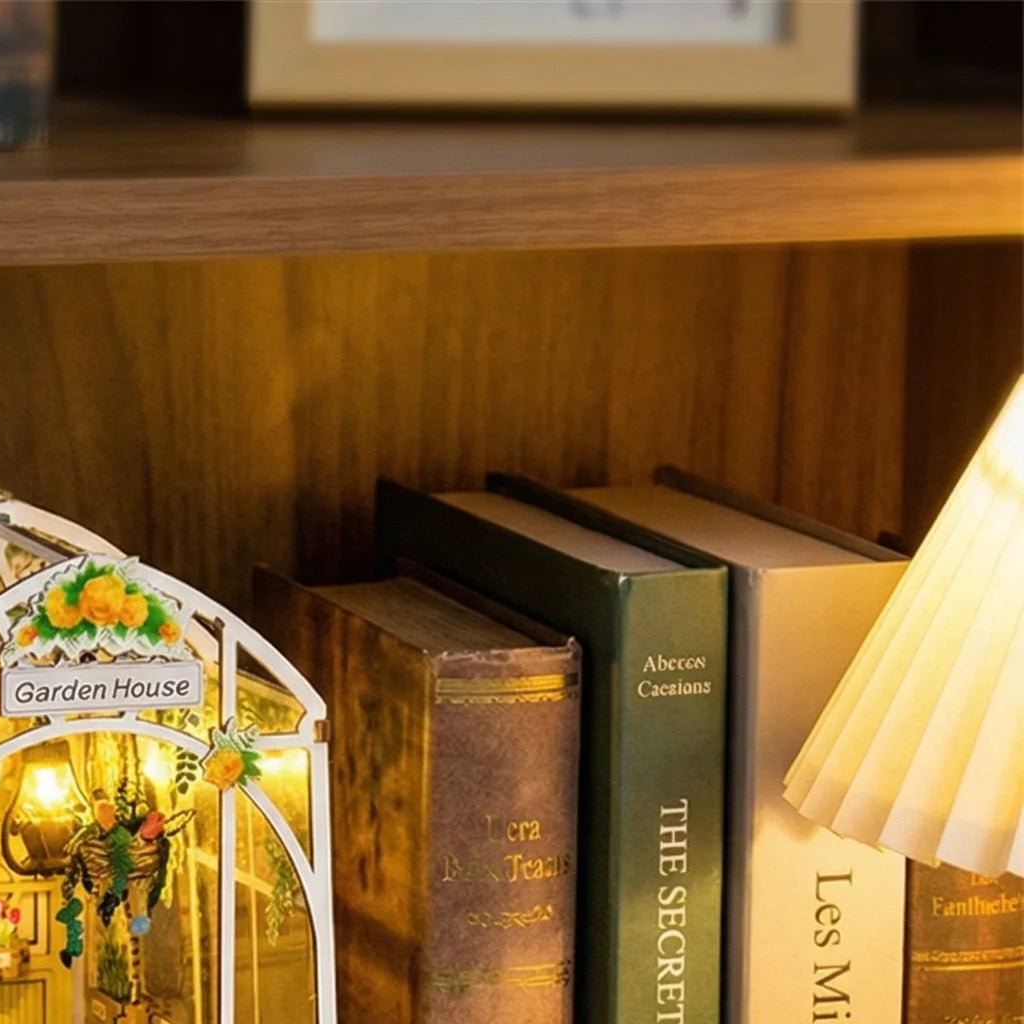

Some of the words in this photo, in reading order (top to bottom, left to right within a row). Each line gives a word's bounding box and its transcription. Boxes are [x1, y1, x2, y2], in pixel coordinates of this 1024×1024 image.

[14, 679, 106, 704] Garden
[111, 677, 190, 699] House
[658, 798, 690, 876] THE
[814, 868, 854, 948] Les
